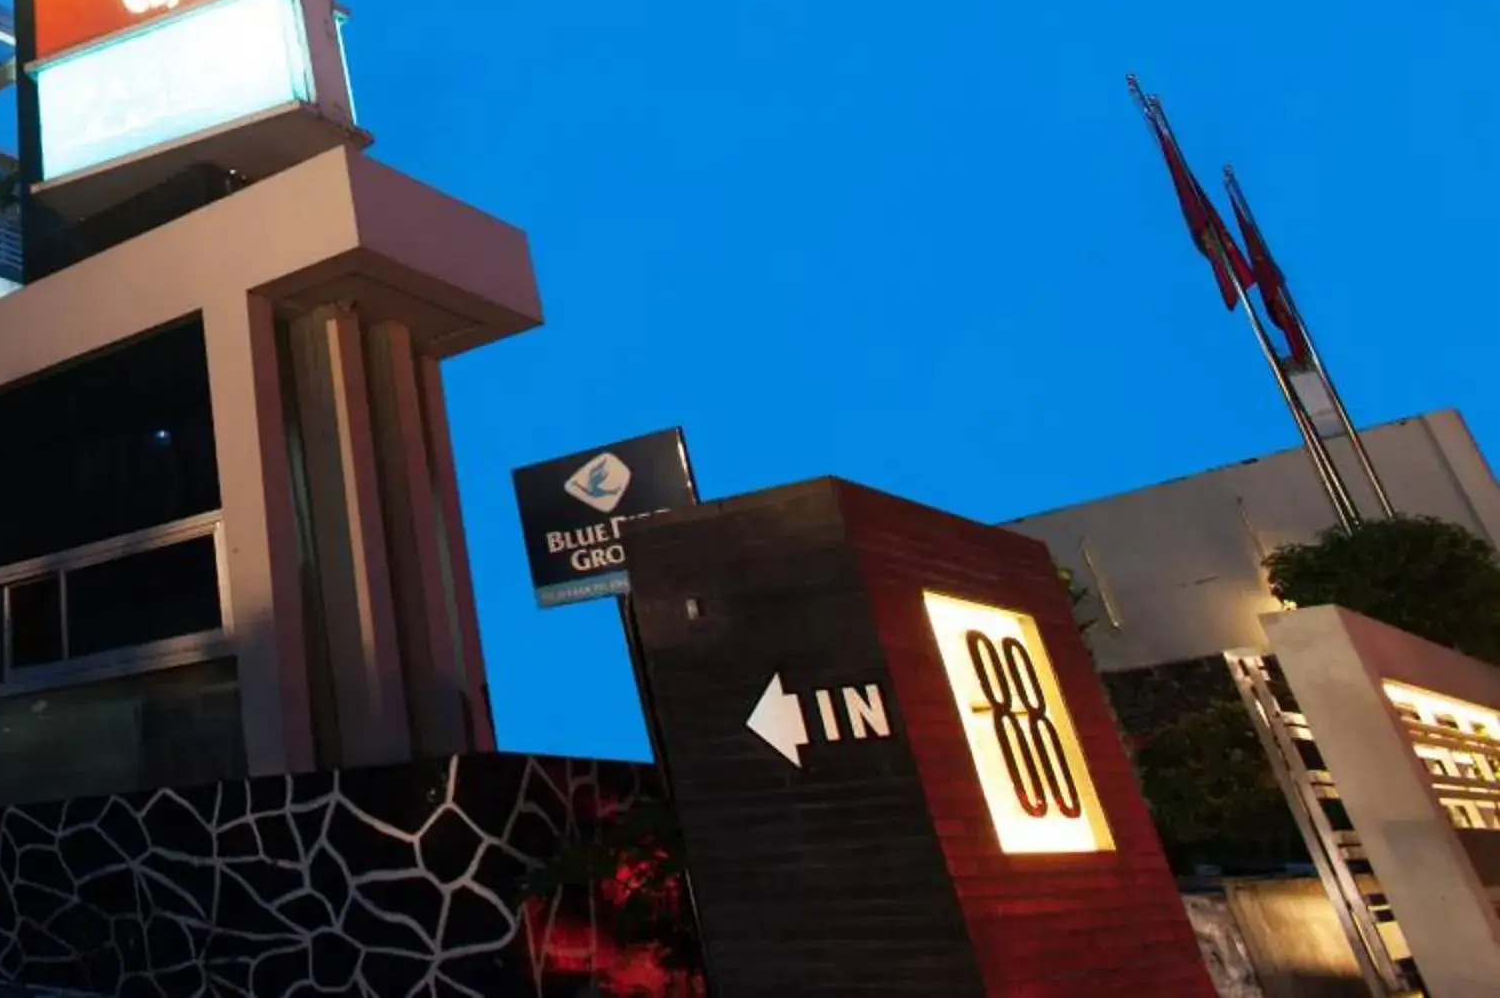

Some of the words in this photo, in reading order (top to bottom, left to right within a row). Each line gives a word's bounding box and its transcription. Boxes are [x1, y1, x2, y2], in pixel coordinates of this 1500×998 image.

[545, 522, 609, 553] BLUE
[570, 545, 626, 571] GRO
[815, 683, 891, 741] IN
